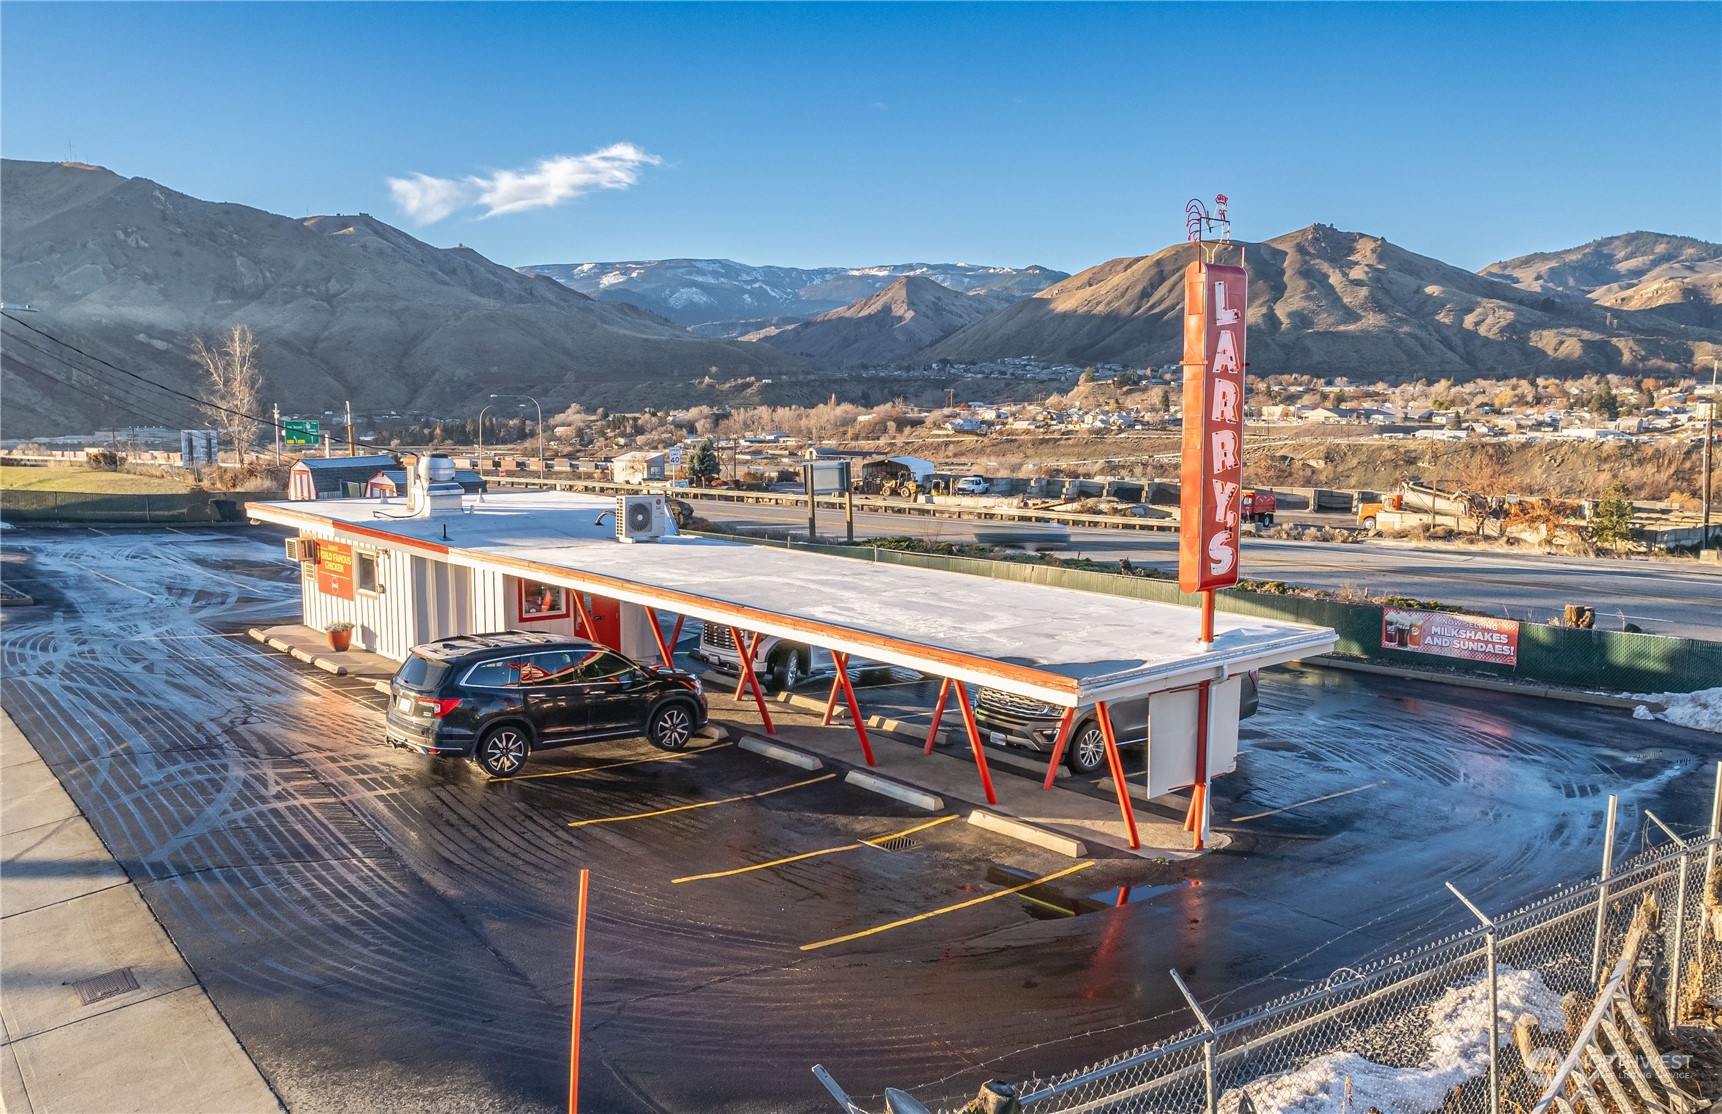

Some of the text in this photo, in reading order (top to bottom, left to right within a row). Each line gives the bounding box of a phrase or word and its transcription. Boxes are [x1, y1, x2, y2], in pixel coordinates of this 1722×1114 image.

[1208, 280, 1241, 577] LARRY'S
[333, 553, 351, 565] FAMOUS
[324, 561, 345, 573] CHICKEN
[1443, 619, 1498, 630] NOW SELLING
[1431, 626, 1508, 643] MILKSHAKES
[1425, 636, 1514, 655] AND SUNDAES!
